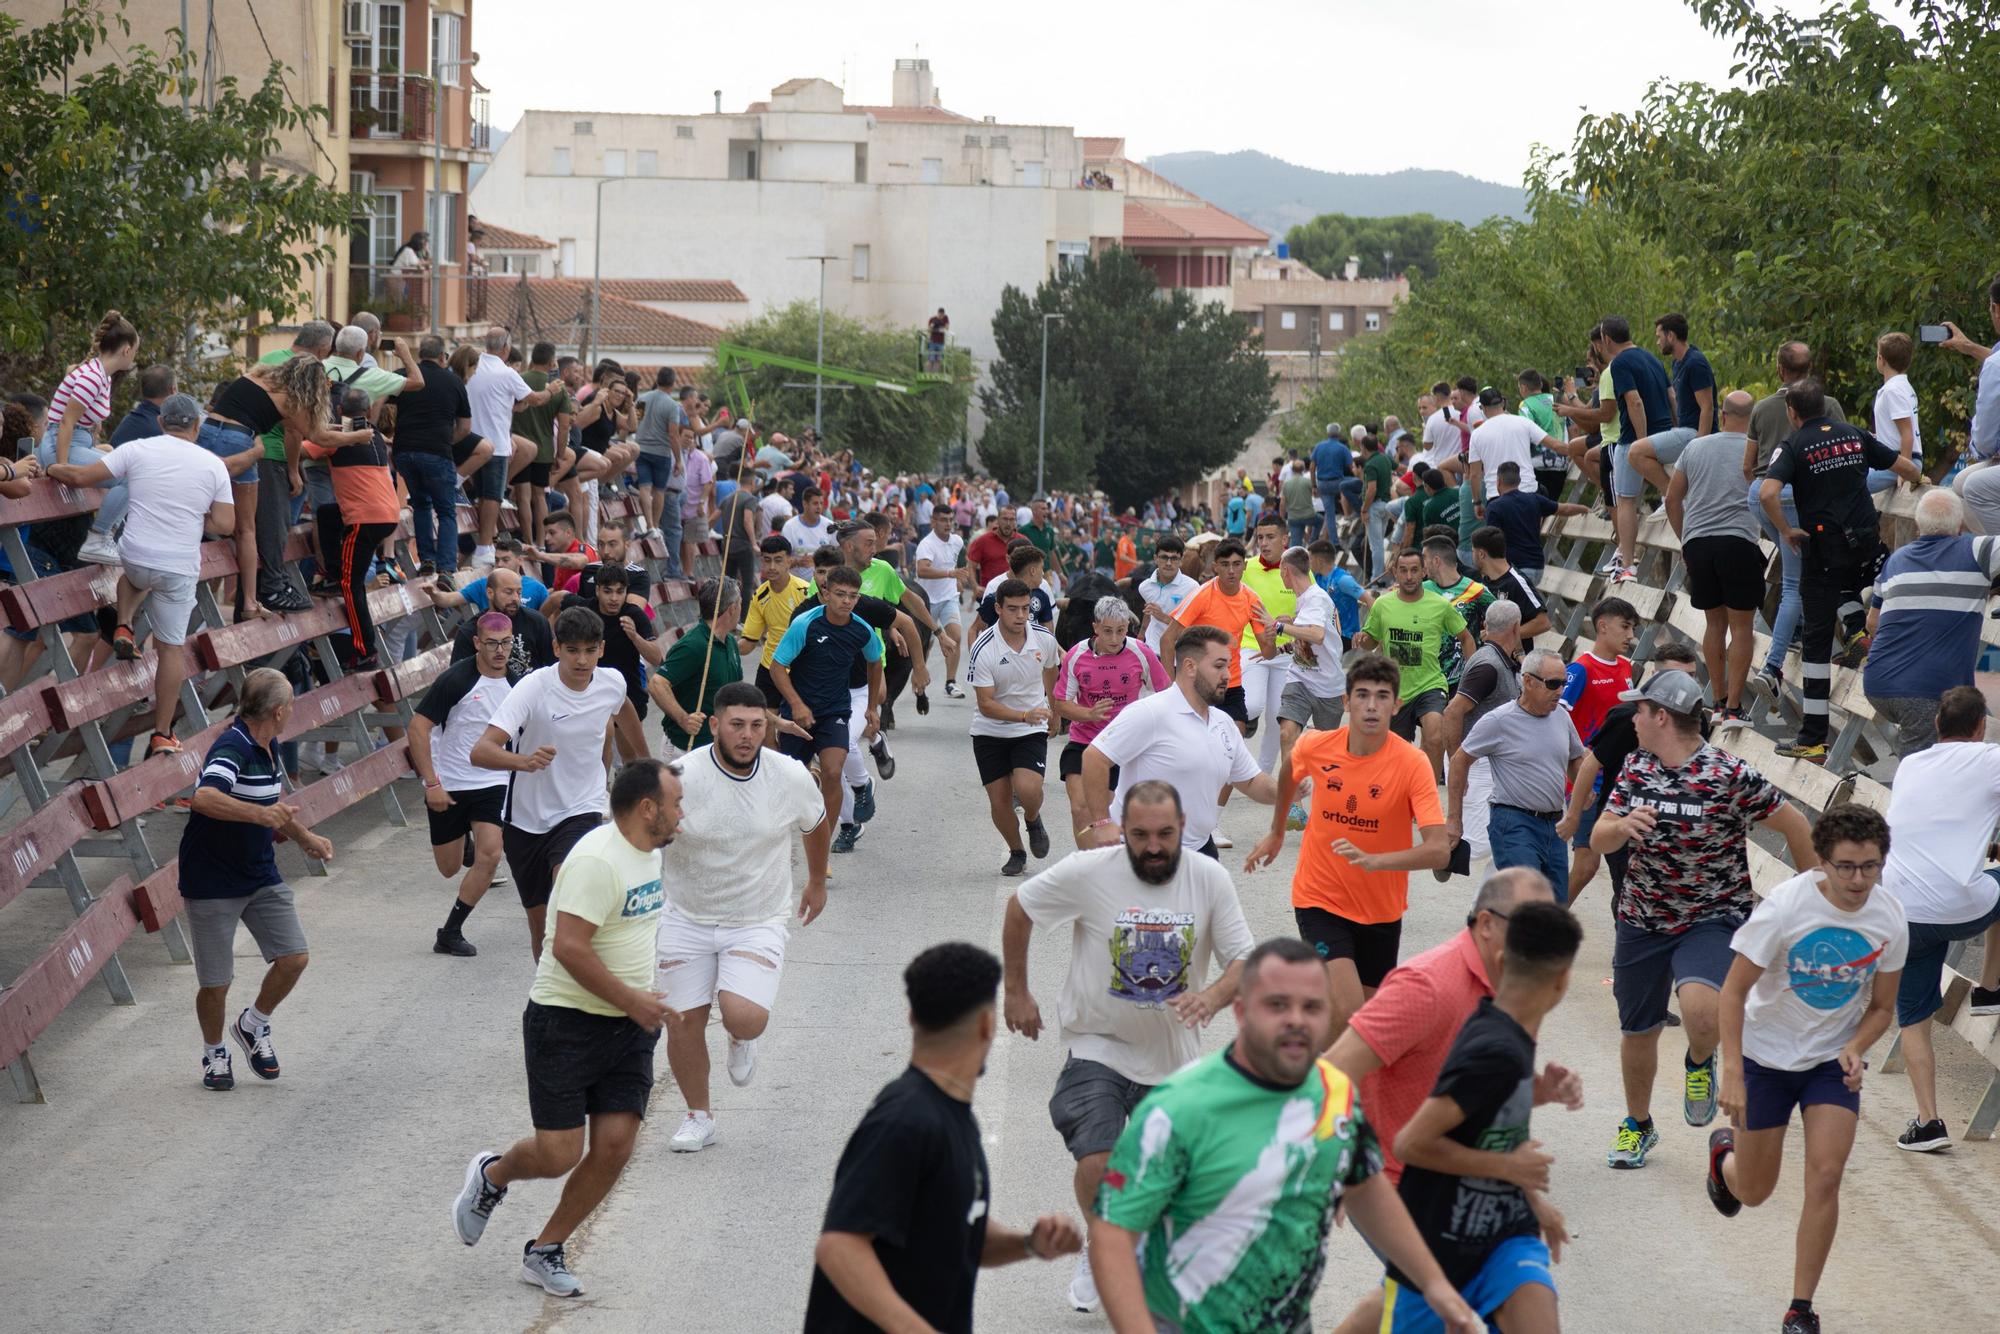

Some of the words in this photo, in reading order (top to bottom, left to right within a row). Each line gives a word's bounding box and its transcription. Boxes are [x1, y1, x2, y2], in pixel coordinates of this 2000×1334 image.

[1807, 447, 1830, 464] 112
[1813, 459, 1863, 474] CALASPARRA
[1659, 801, 1678, 814] FOR
[1680, 803, 1702, 817] YOU
[1322, 810, 1379, 829] ortodent
[1115, 911, 1195, 925] JACK&JONES
[1792, 957, 1868, 984] NASA
